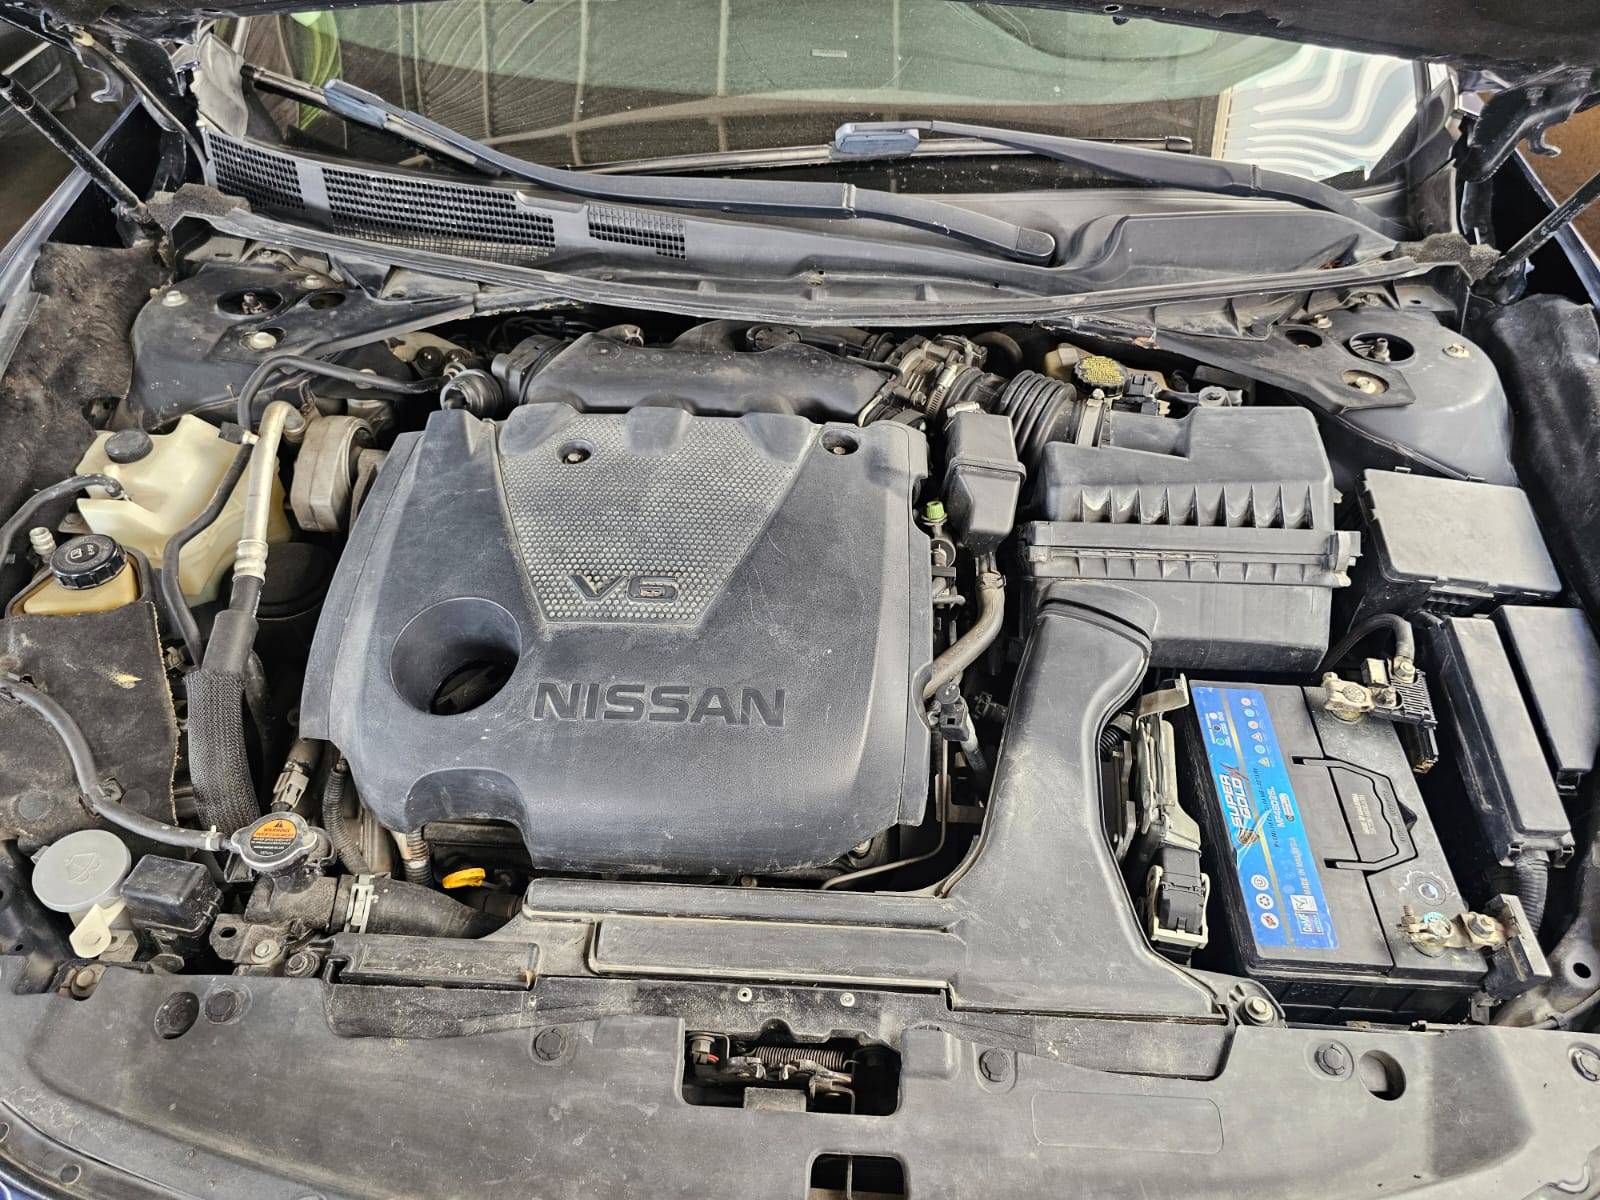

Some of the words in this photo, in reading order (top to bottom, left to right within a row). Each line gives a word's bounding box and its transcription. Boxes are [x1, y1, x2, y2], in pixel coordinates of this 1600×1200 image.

[568, 574, 681, 604] V6
[533, 681, 787, 728] NISSAN
[1218, 774, 1242, 826] SUPER
[1230, 777, 1252, 818] GOLD
